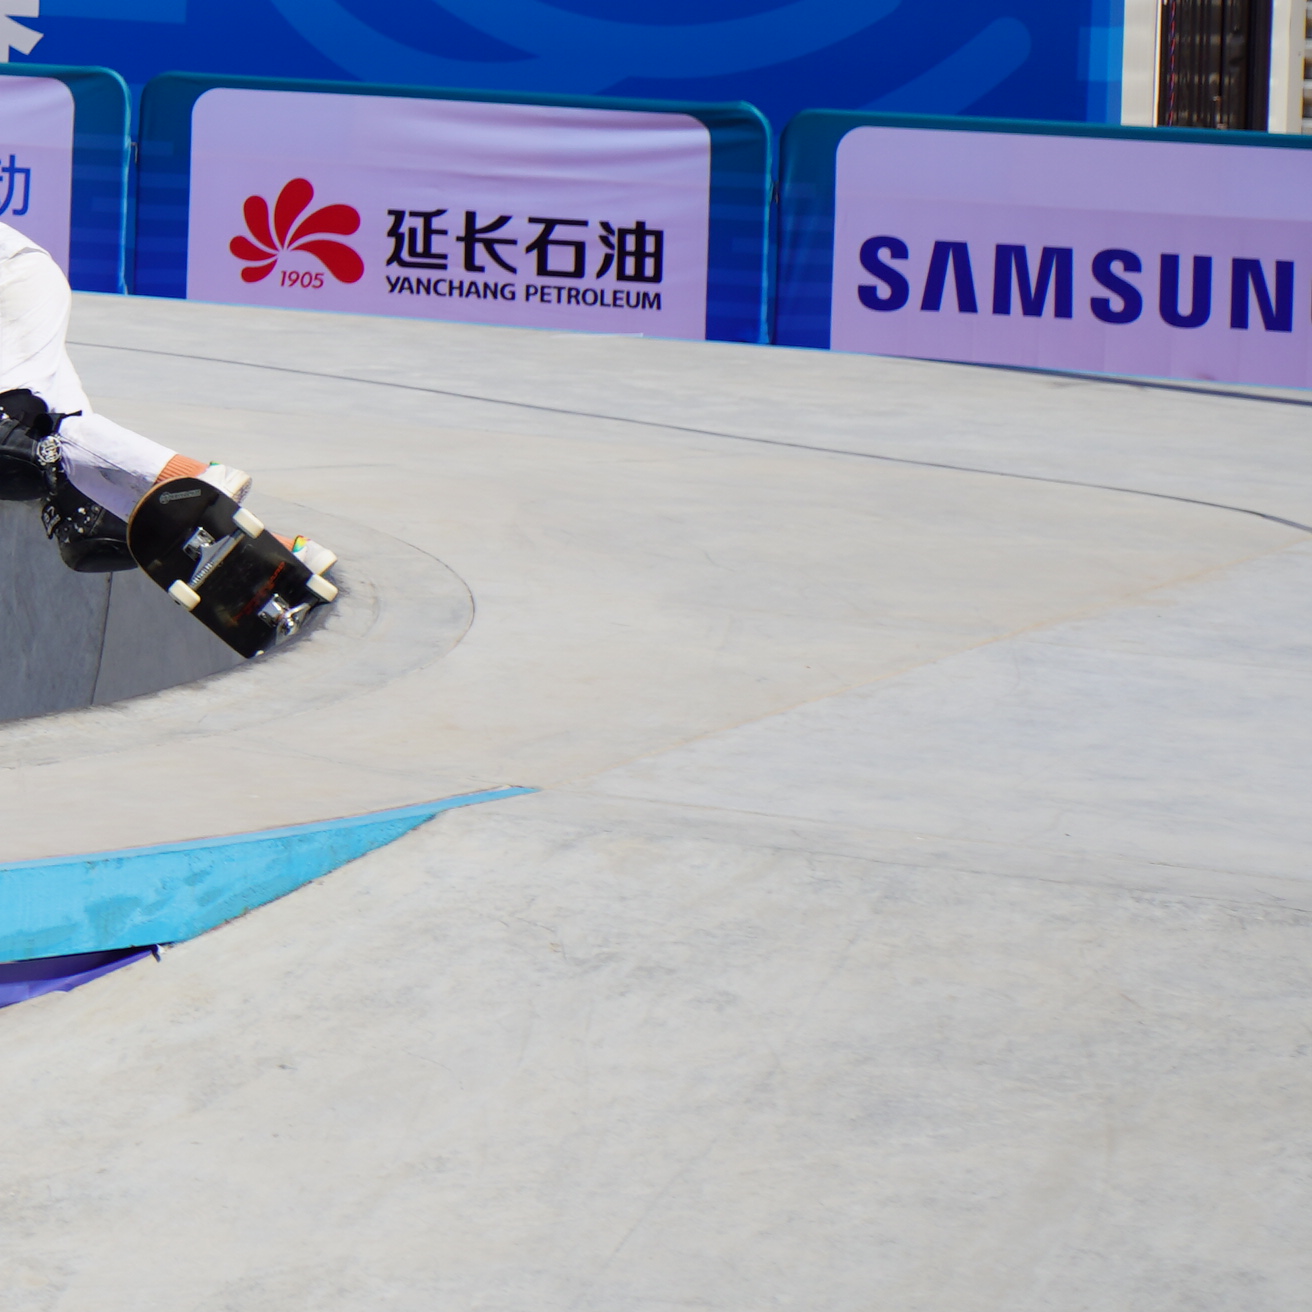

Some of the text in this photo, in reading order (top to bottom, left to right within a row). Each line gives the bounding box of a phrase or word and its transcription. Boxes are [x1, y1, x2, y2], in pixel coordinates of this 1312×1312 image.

[385, 207, 665, 285] 延长石油
[279, 269, 325, 290] 1905
[385, 274, 664, 312] YANCHANG PETROLEUM
[856, 234, 1312, 334] SAMSUN
